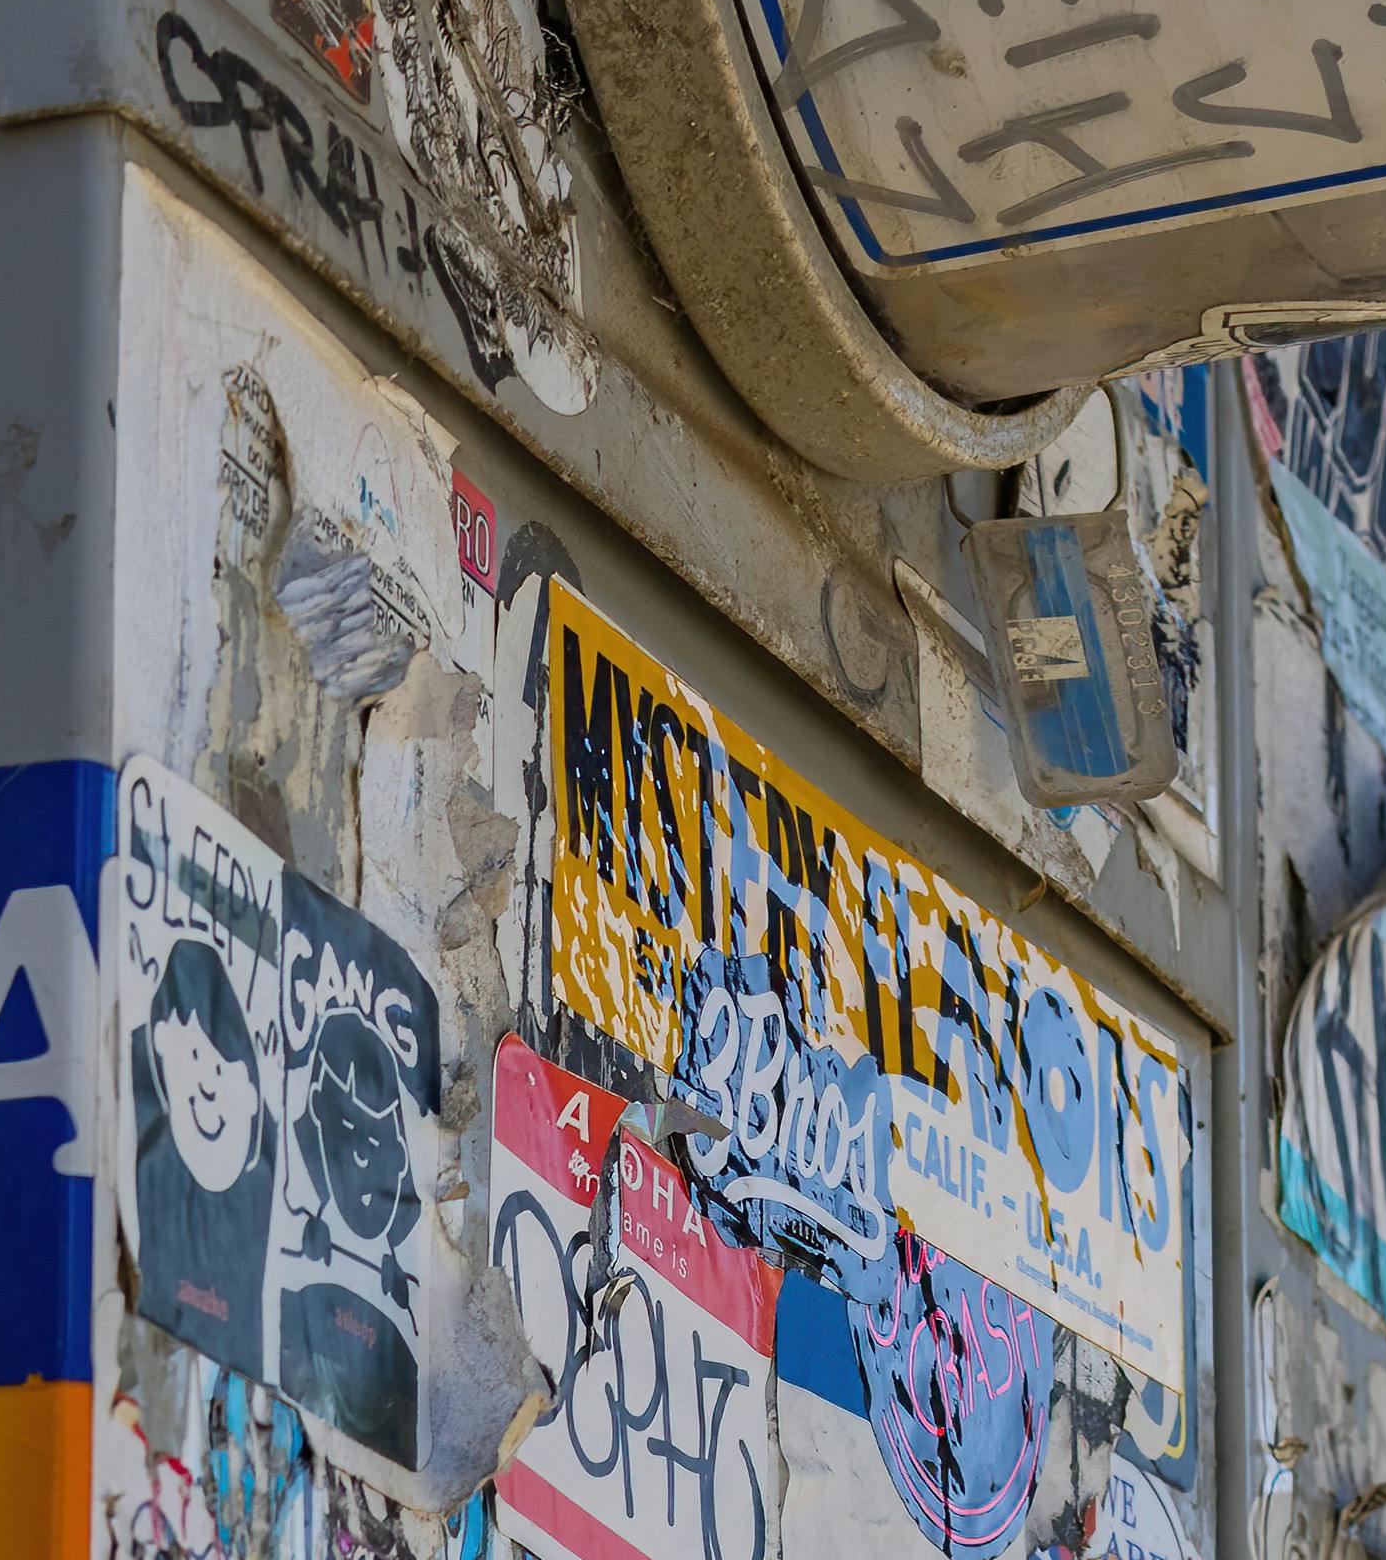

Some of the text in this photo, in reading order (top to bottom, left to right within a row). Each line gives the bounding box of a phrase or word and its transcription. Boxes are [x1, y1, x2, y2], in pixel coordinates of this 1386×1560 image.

[126, 776, 419, 1068] SLEEPY GANG
[556, 1090, 709, 1252] AOHA
[623, 1210, 667, 1262] ame
[903, 1108, 992, 1219] CALIF.
[1025, 1199, 1102, 1288] U.S.A.
